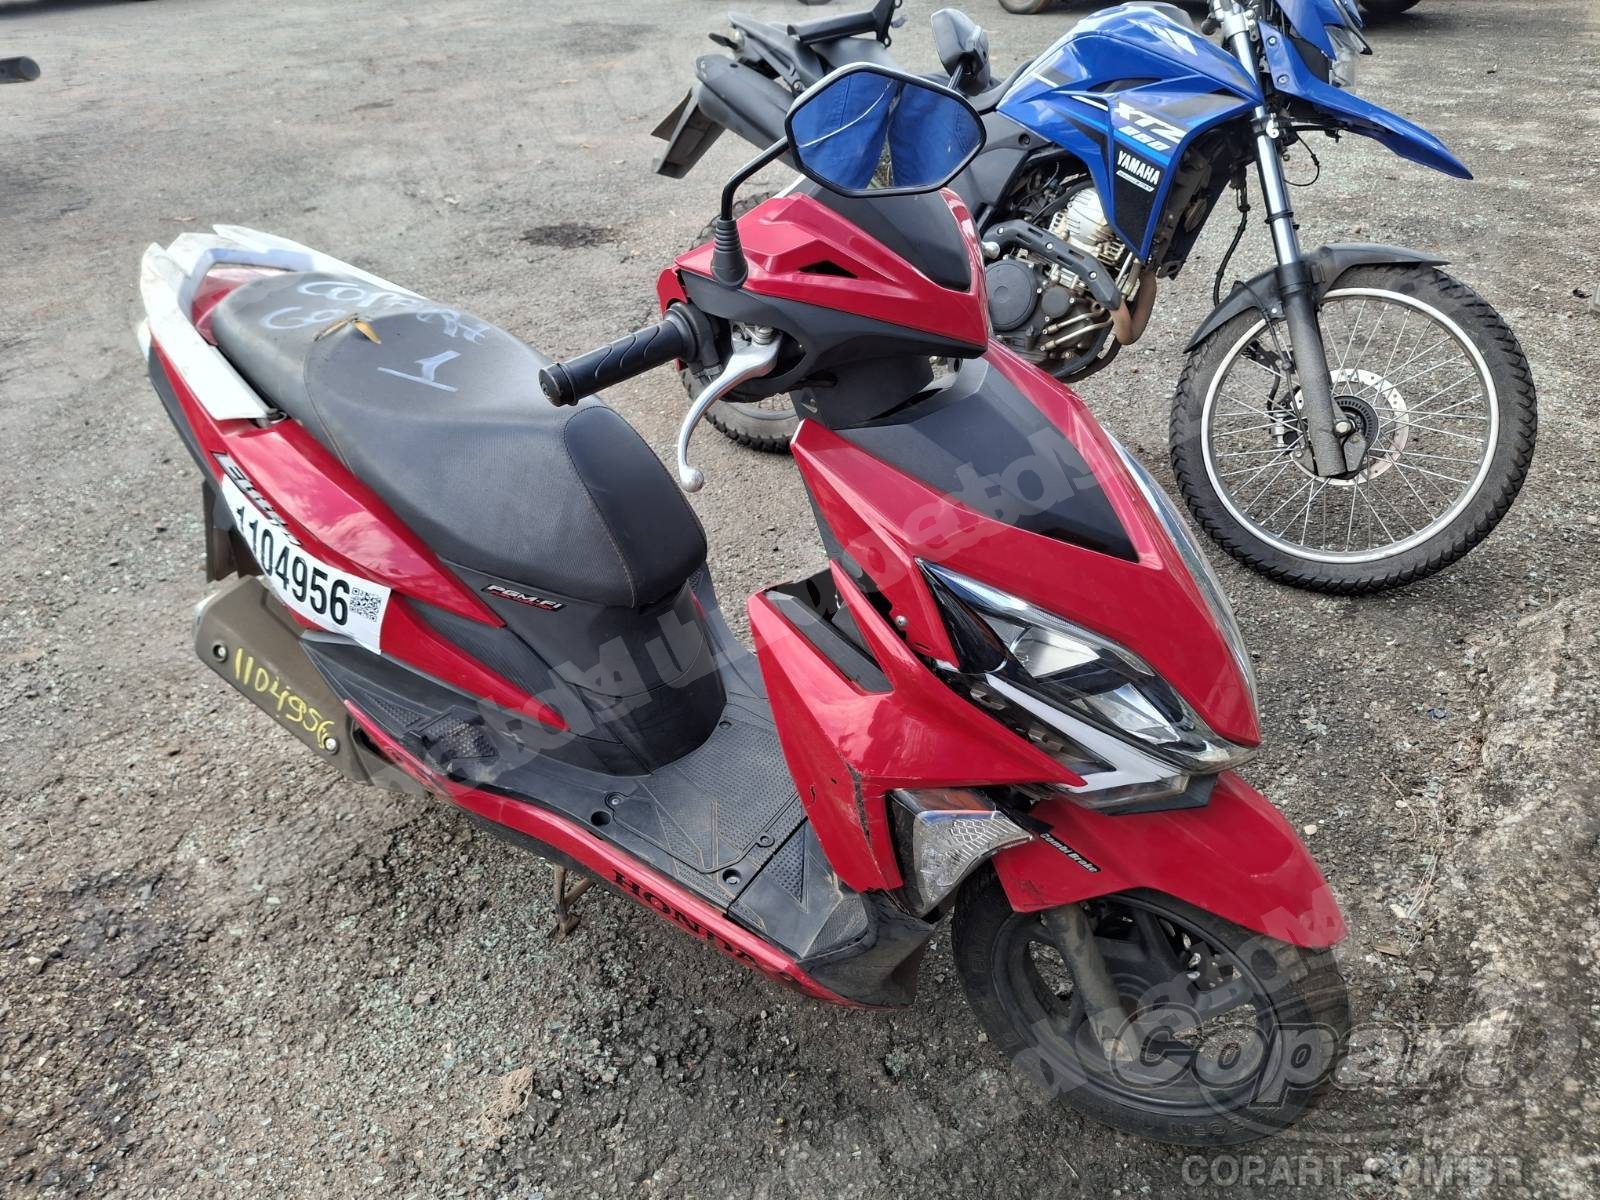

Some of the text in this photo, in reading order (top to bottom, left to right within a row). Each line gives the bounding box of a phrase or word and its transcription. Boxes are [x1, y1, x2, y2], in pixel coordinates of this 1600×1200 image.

[1114, 102, 1187, 144] XTZ
[1117, 150, 1160, 185] YAMAHA
[230, 505, 350, 626] 1104956
[233, 647, 336, 749] 1104956
[613, 869, 758, 966] HONDA
